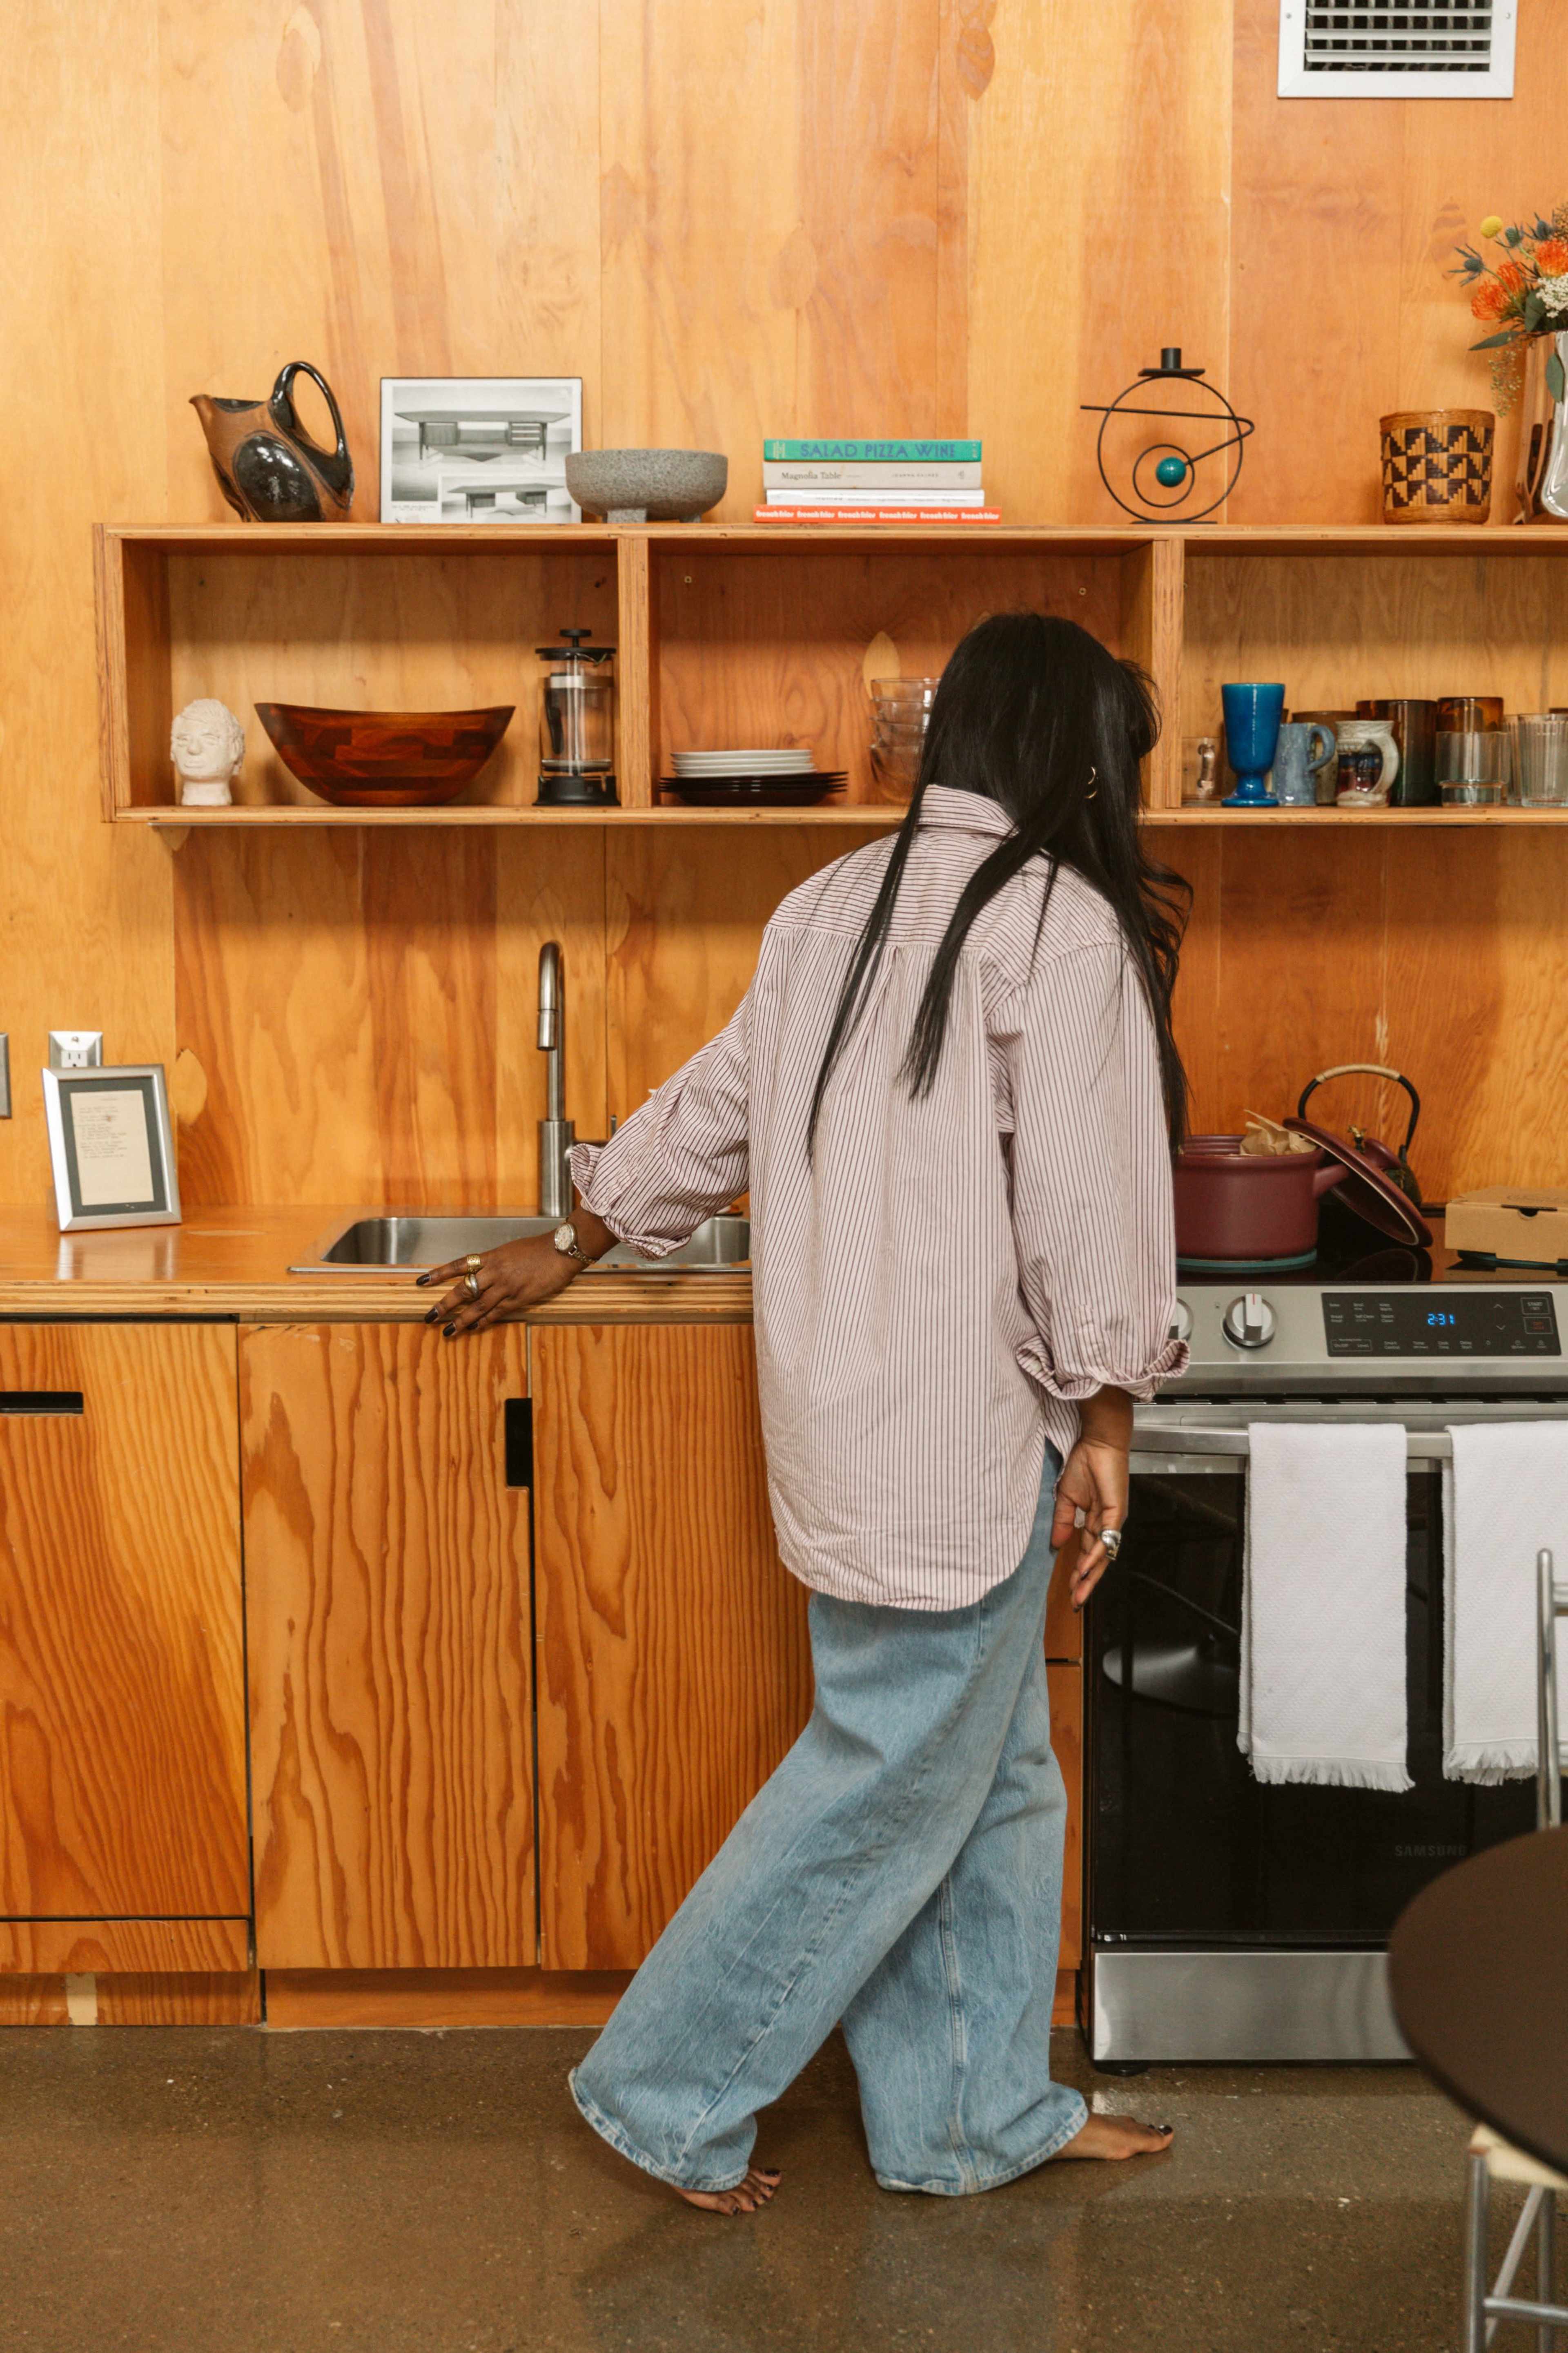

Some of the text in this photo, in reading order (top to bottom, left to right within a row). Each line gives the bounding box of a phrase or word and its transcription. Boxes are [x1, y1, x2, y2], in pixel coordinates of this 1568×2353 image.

[801, 444, 857, 457] SALAD
[865, 444, 909, 457] PIZZA
[915, 444, 955, 458] WINE
[782, 471, 818, 480] Magnolia
[1428, 1314, 1454, 1325] 2:31
[1394, 1845, 1467, 1856] SAMSUNG
